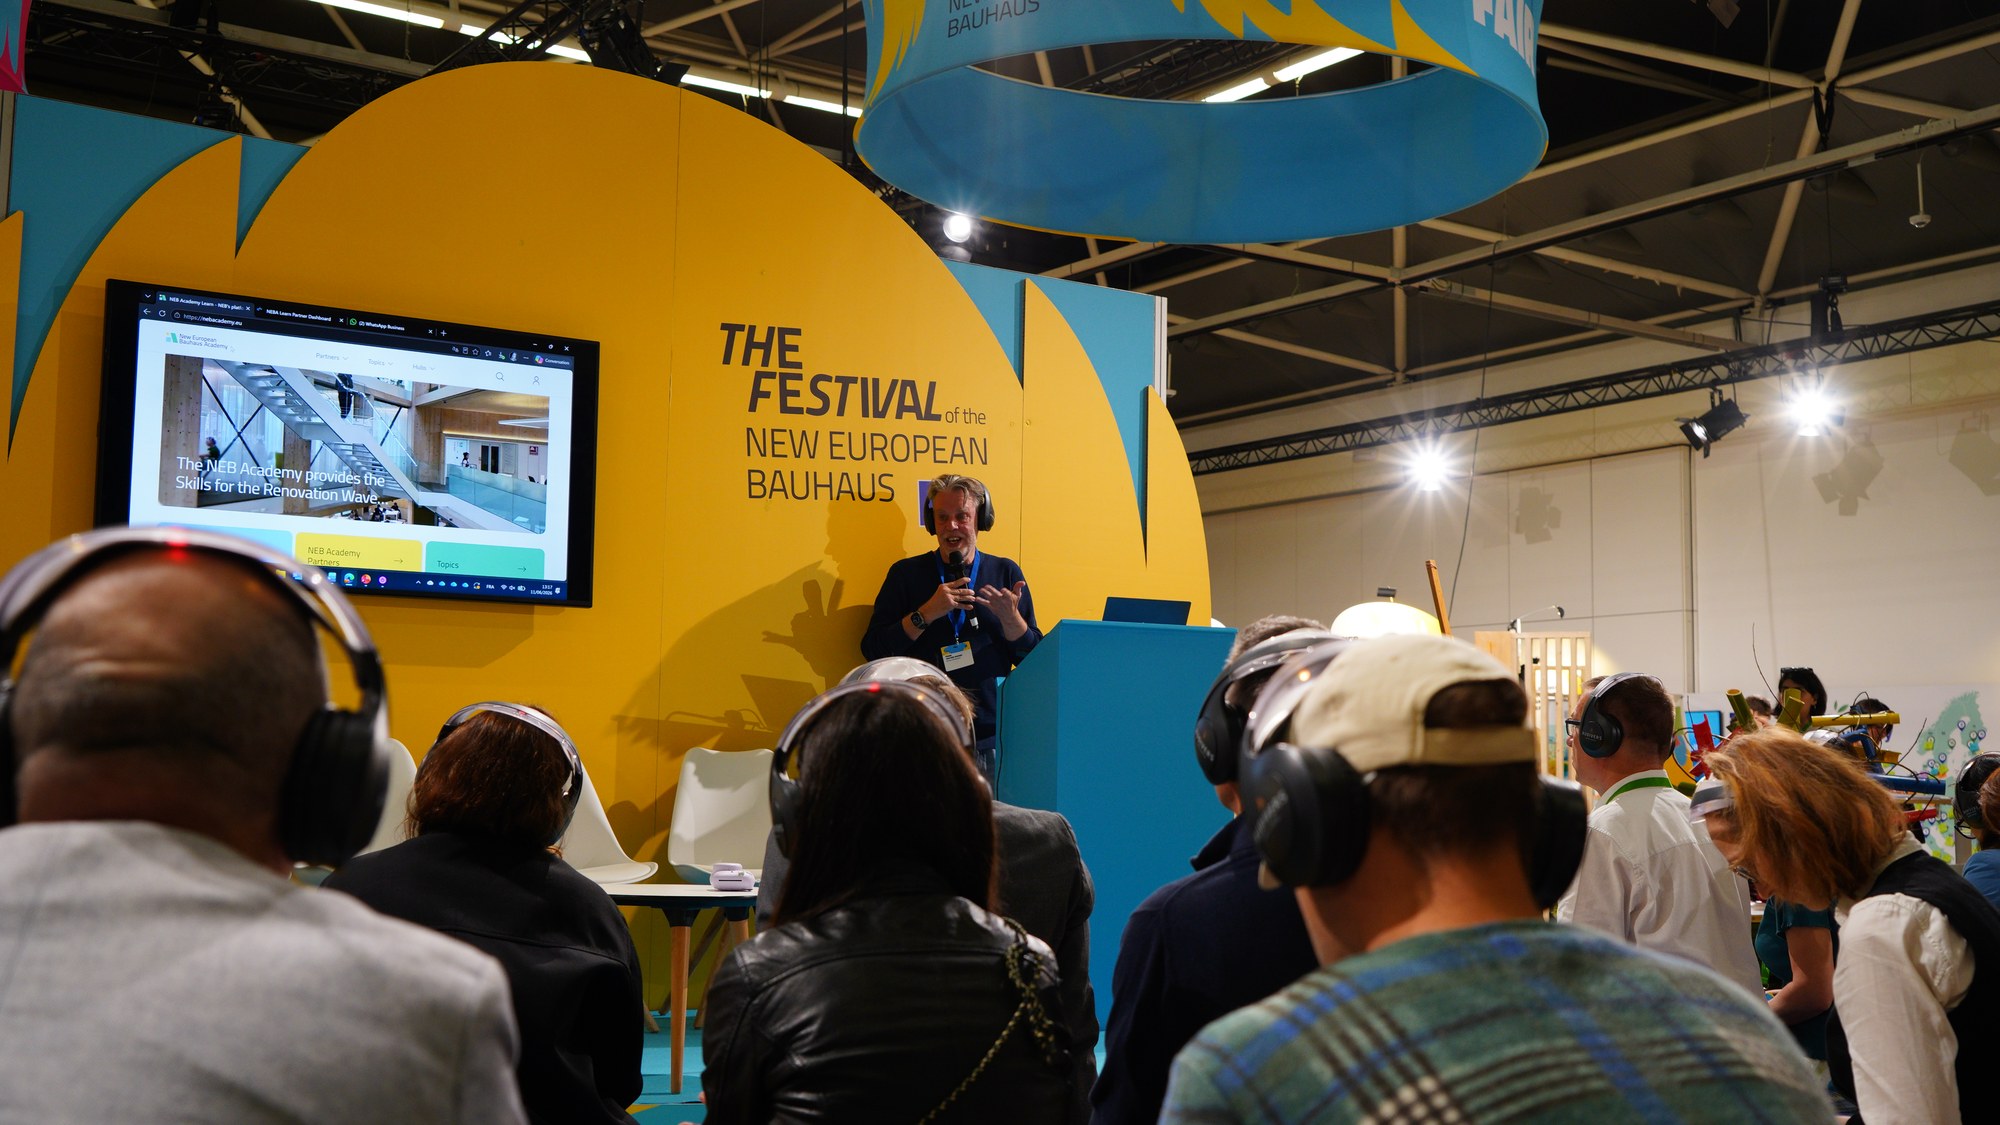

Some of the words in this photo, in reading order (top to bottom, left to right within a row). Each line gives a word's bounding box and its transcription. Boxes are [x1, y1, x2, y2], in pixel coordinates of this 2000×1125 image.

[947, 0, 1040, 38] BAUHAUS
[183, 314, 242, 326] https://nebacademy.eu
[308, 314, 331, 322] Dashboard
[204, 342, 228, 350] Academy
[720, 322, 803, 370] THE
[316, 353, 339, 361] Partners
[368, 358, 385, 366] Topics
[748, 370, 942, 422] FESTIVAL
[945, 407, 960, 424] of
[963, 408, 986, 424] the
[746, 427, 819, 459] NEW
[829, 430, 988, 465] EUROPEAN
[176, 456, 203, 472] The
[206, 459, 237, 474] NEB
[240, 462, 303, 484] Academy
[306, 468, 360, 485] provides
[364, 472, 385, 487] the
[176, 476, 211, 490] Skills
[215, 478, 235, 493] for
[238, 480, 260, 495] the
[263, 482, 338, 501] Renovation
[341, 490, 388, 505] Wave...
[747, 469, 895, 502] BAUHAUS
[307, 546, 324, 555] NEB
[326, 548, 361, 559] Academy
[307, 558, 340, 566] Partners
[437, 560, 459, 570] Topics
